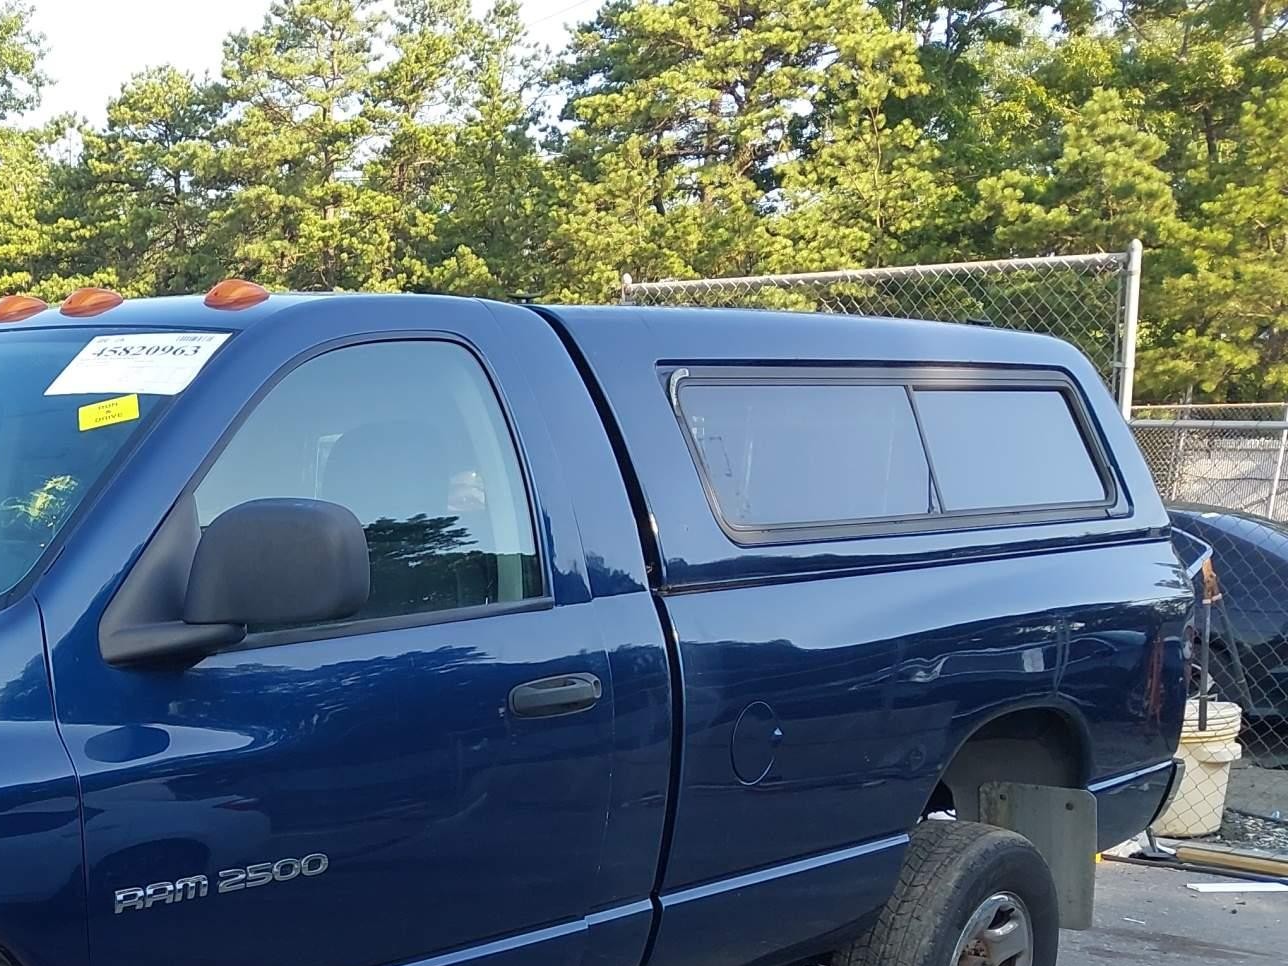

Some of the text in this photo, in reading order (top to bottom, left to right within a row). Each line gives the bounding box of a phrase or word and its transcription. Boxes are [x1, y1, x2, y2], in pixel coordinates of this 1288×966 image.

[92, 345, 201, 357] 45820963
[114, 853, 329, 914] RAM 2500
